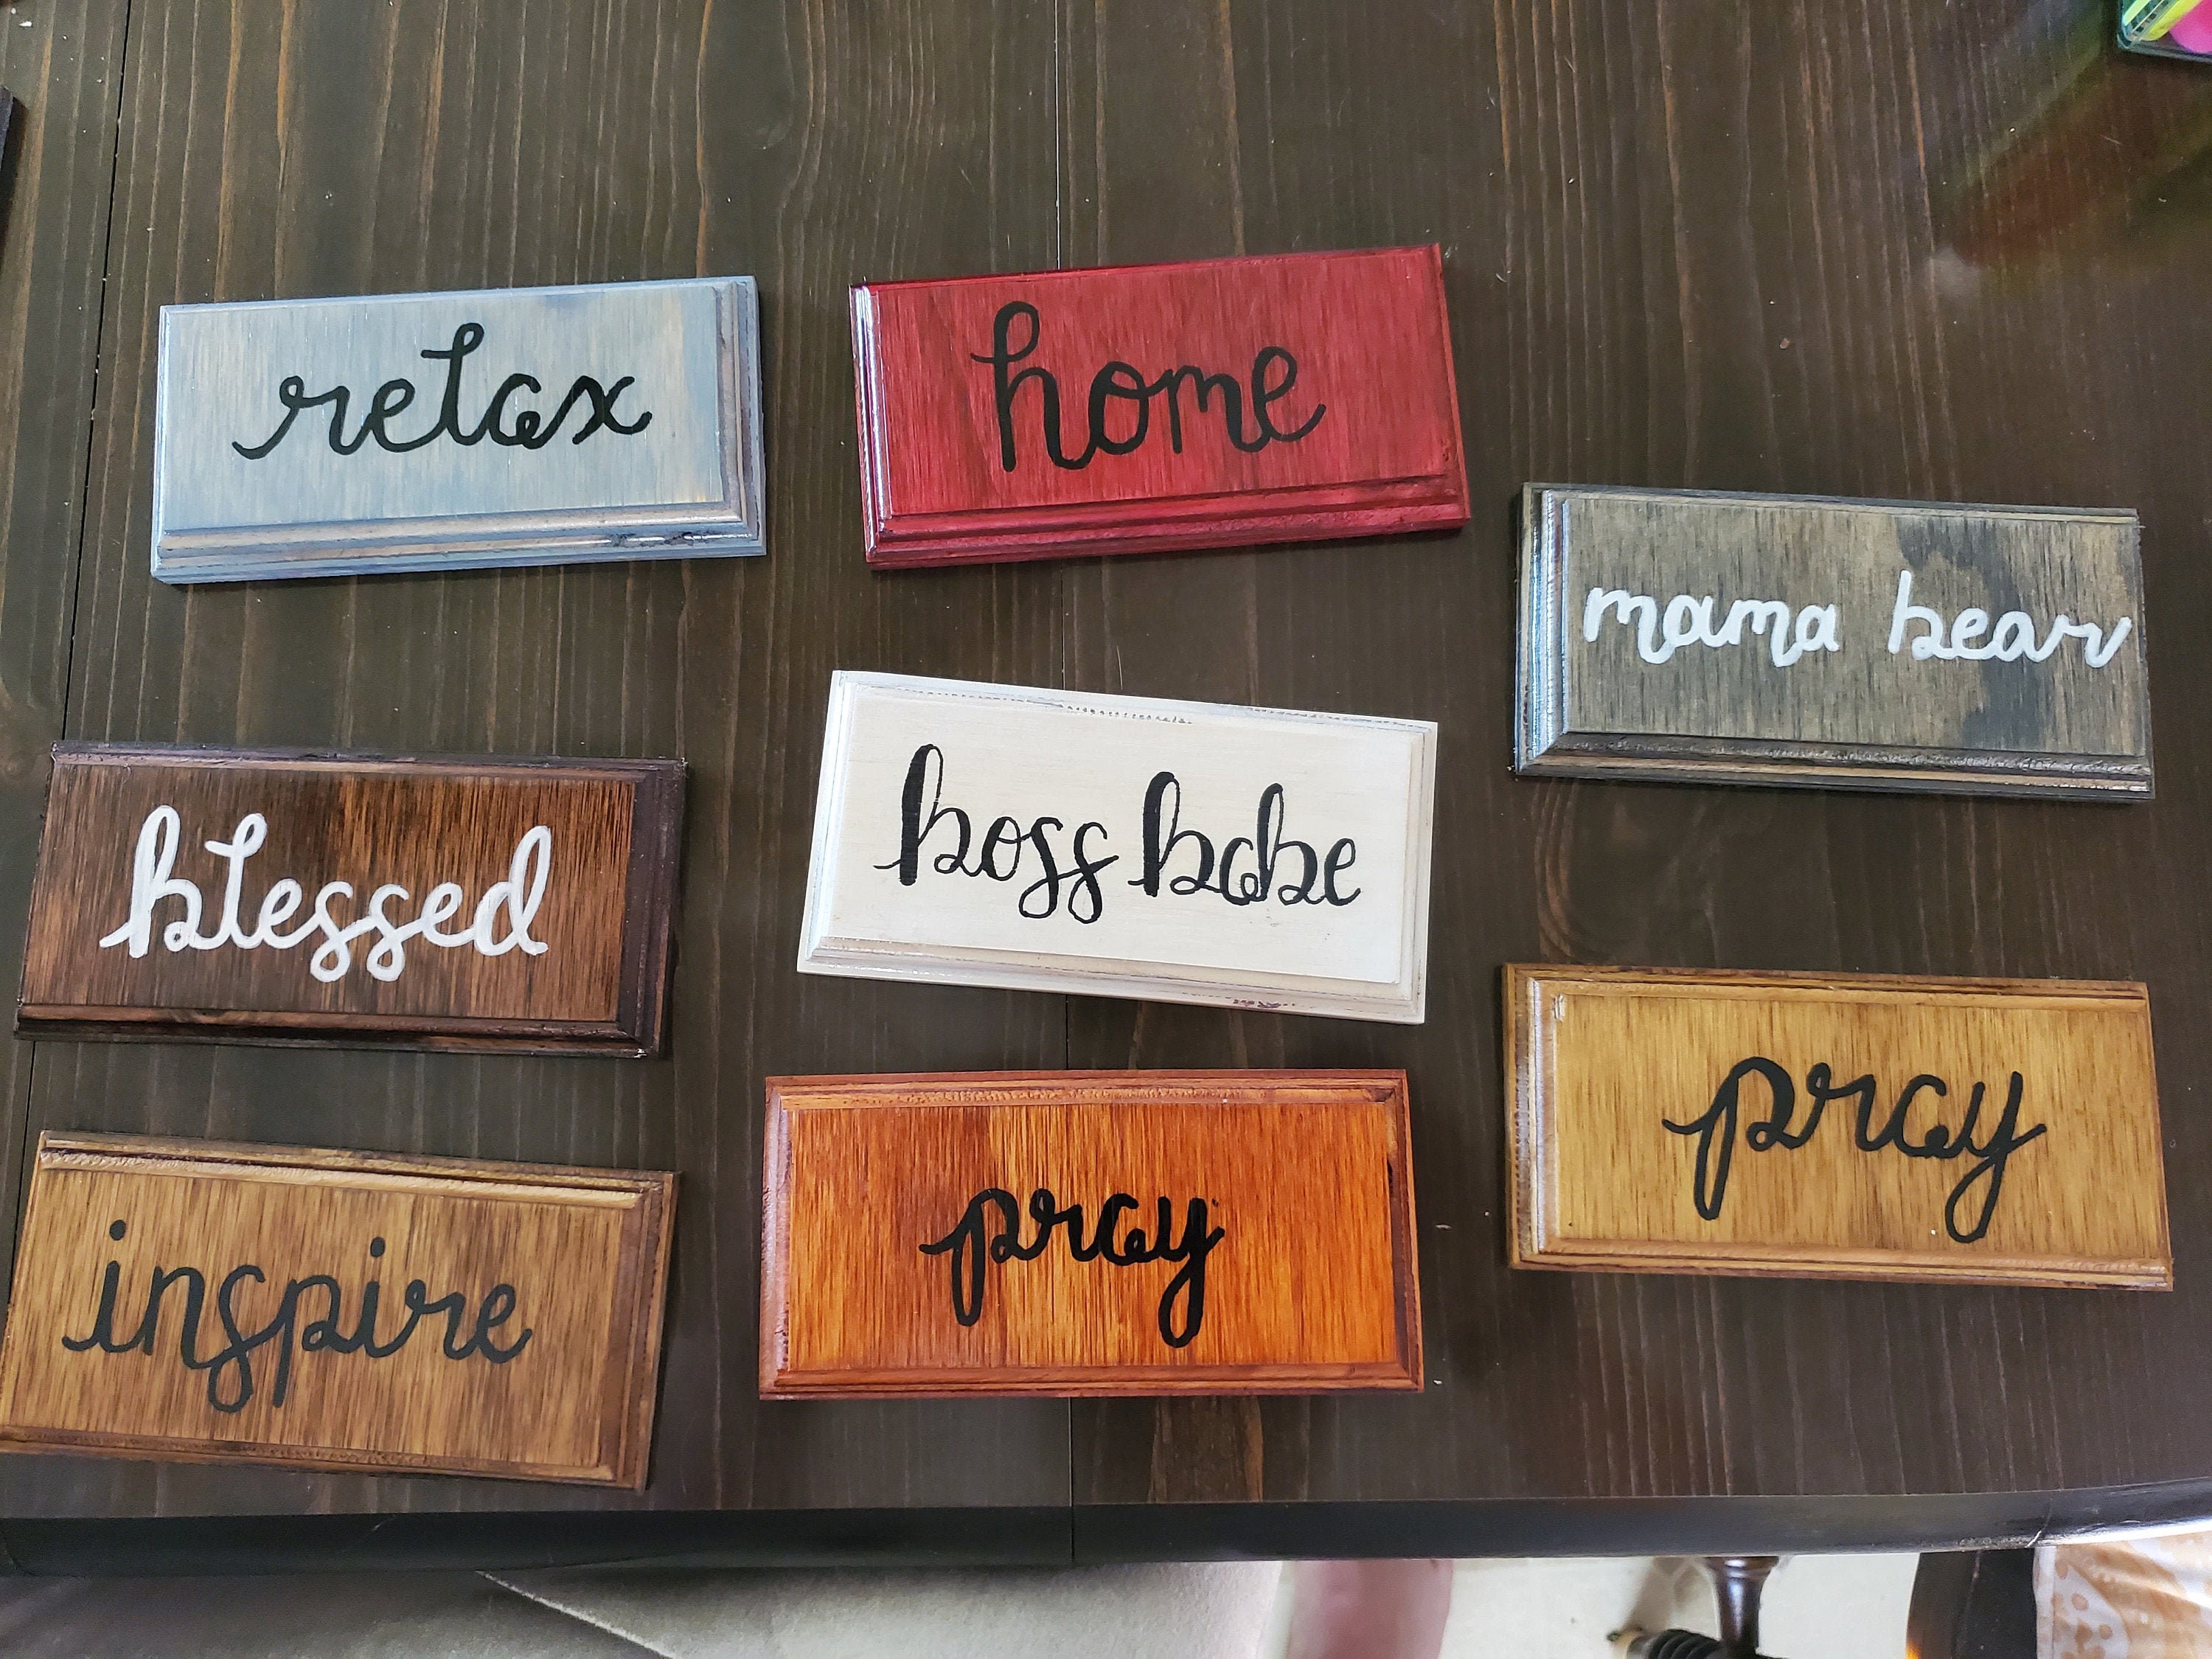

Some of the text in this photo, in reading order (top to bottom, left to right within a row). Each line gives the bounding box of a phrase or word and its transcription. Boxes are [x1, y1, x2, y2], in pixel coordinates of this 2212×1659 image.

[232, 322, 651, 460] relax
[970, 300, 1325, 472] home
[1582, 569, 2132, 668] mama bear
[99, 804, 551, 982] blessed
[873, 744, 1362, 924] boss babe
[1661, 1056, 2048, 1241] pray
[62, 1218, 532, 1414] inspire
[920, 1188, 1224, 1349] pray
